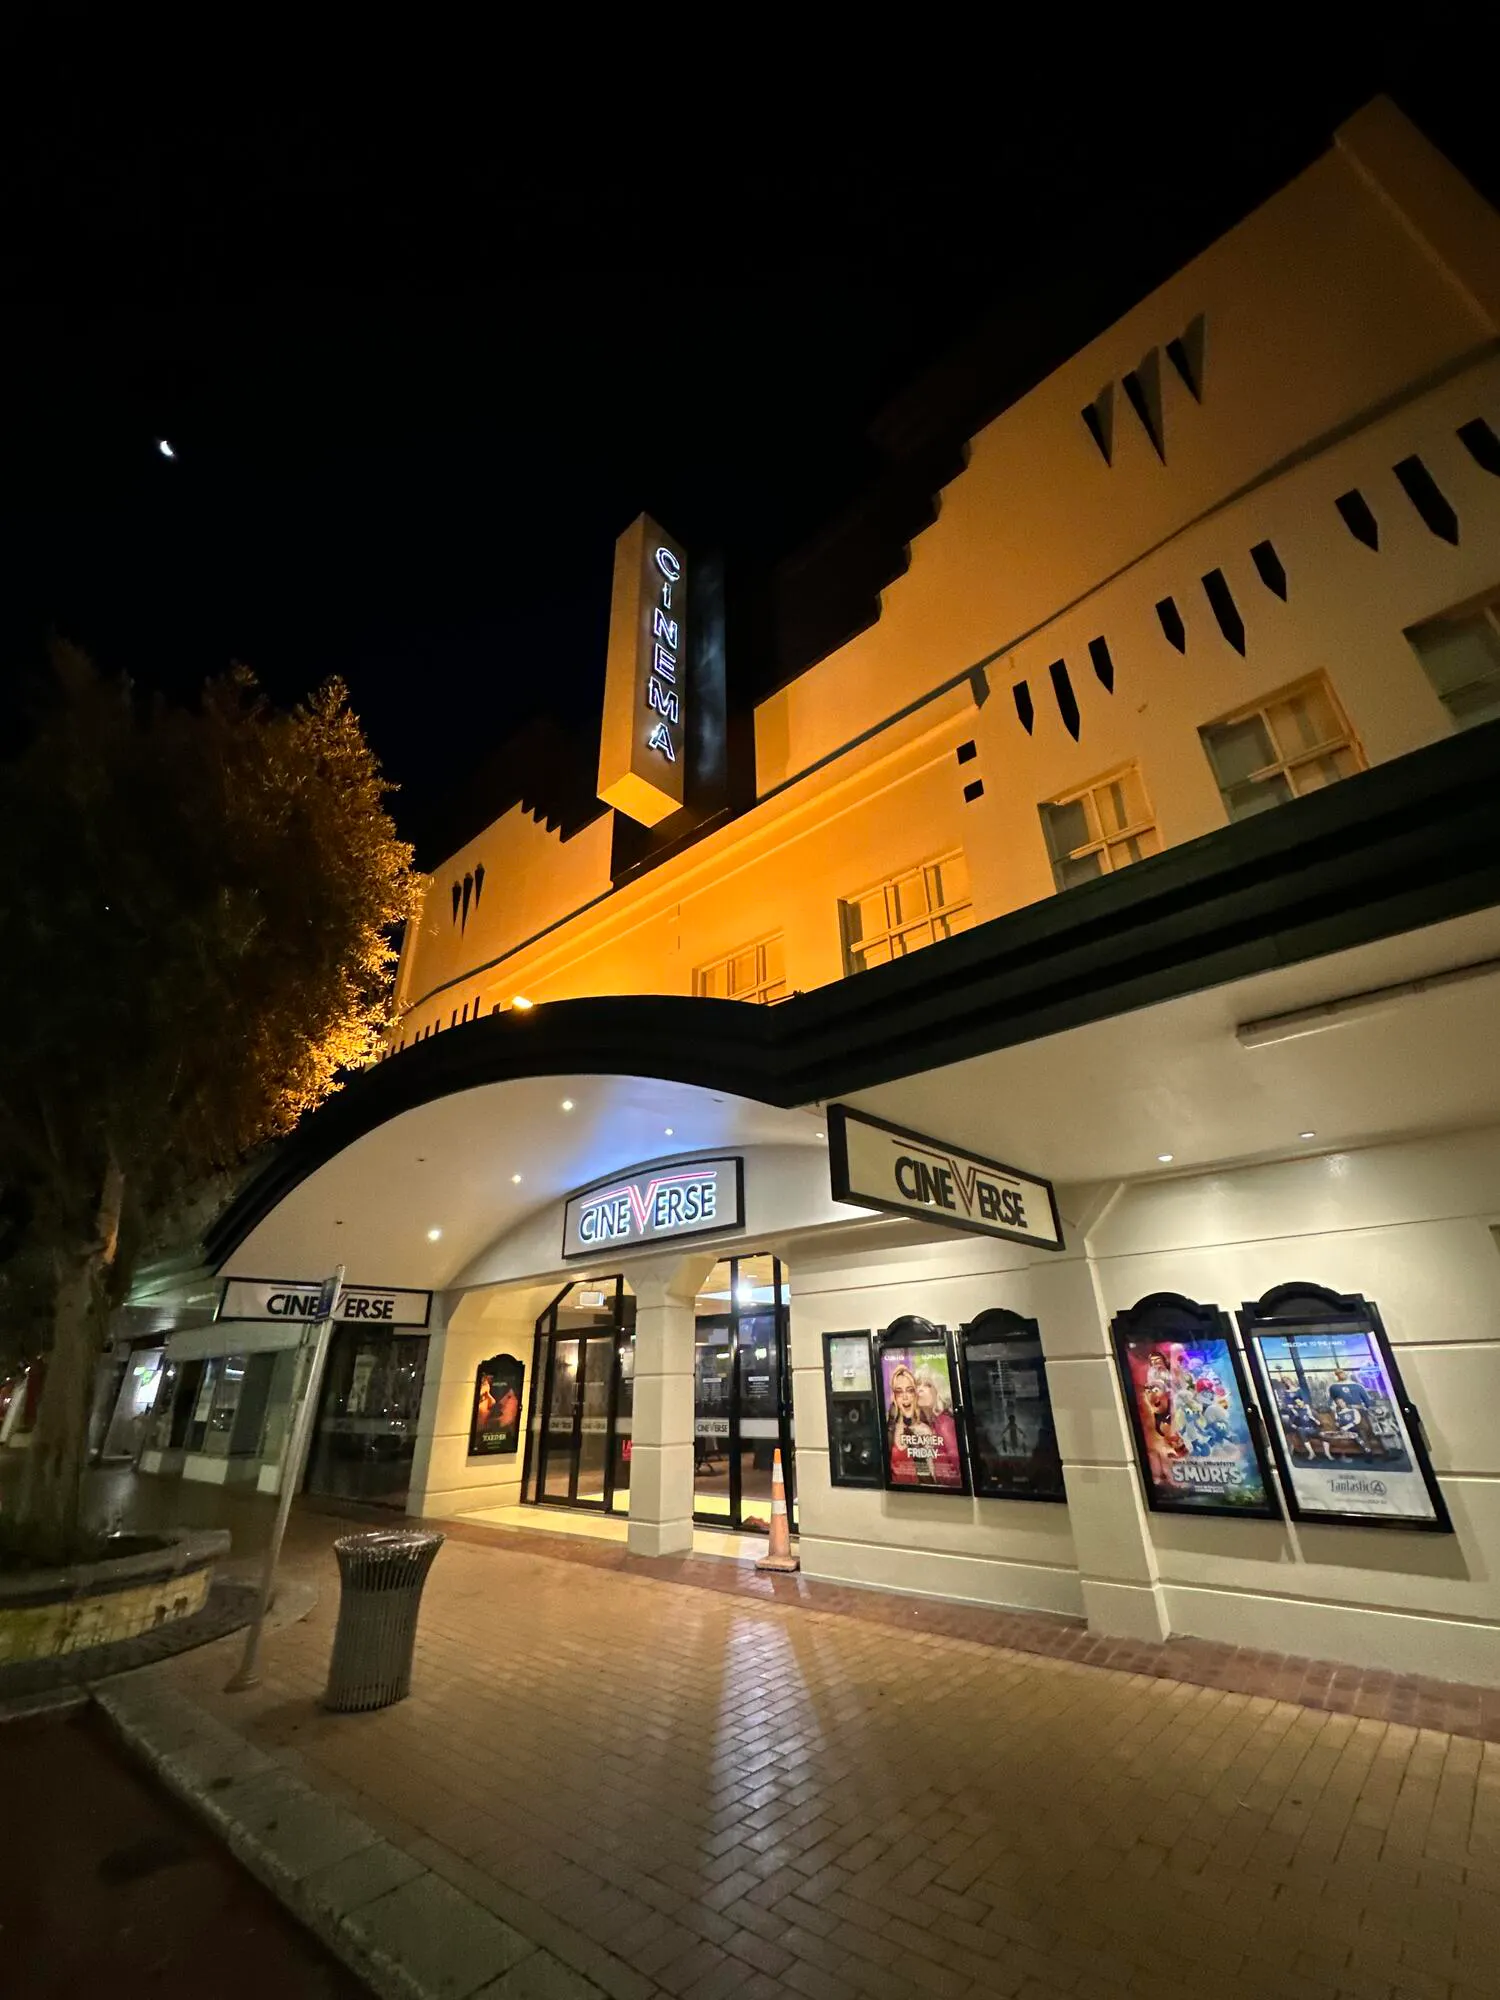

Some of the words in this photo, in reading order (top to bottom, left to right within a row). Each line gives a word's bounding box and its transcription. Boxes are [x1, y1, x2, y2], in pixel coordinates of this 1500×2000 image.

[650, 547, 680, 762] CINEMA
[579, 1173, 717, 1244] CINEVERSE
[894, 1154, 1028, 1228] CINEVERSE
[901, 1434, 944, 1447] FREAKIER
[907, 1447, 938, 1459] FRIDAY
[1172, 1464, 1242, 1484] SMURFS
